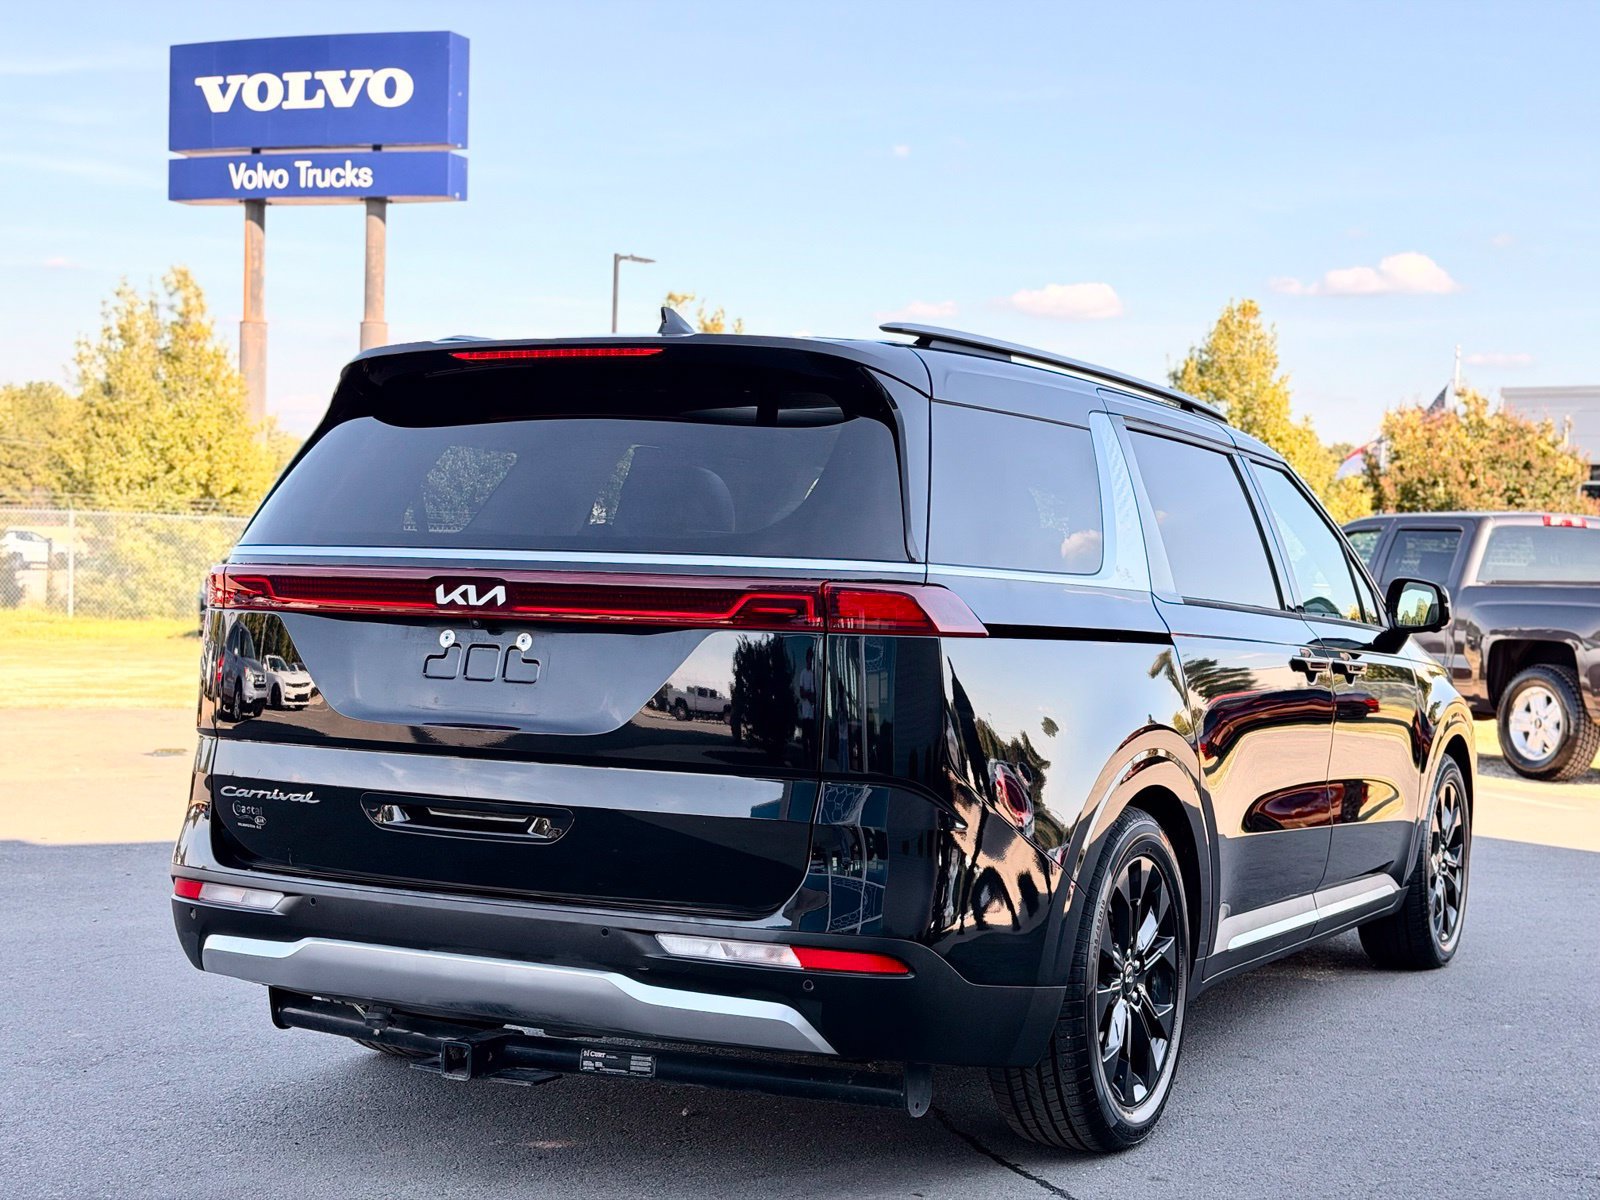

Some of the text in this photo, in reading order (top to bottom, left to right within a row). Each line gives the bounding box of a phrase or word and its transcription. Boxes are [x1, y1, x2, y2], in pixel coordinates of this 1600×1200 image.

[194, 67, 415, 113] VOLVO
[228, 160, 374, 190] Volvo Trucks
[435, 583, 507, 607] KIA
[220, 785, 320, 803] Carnival
